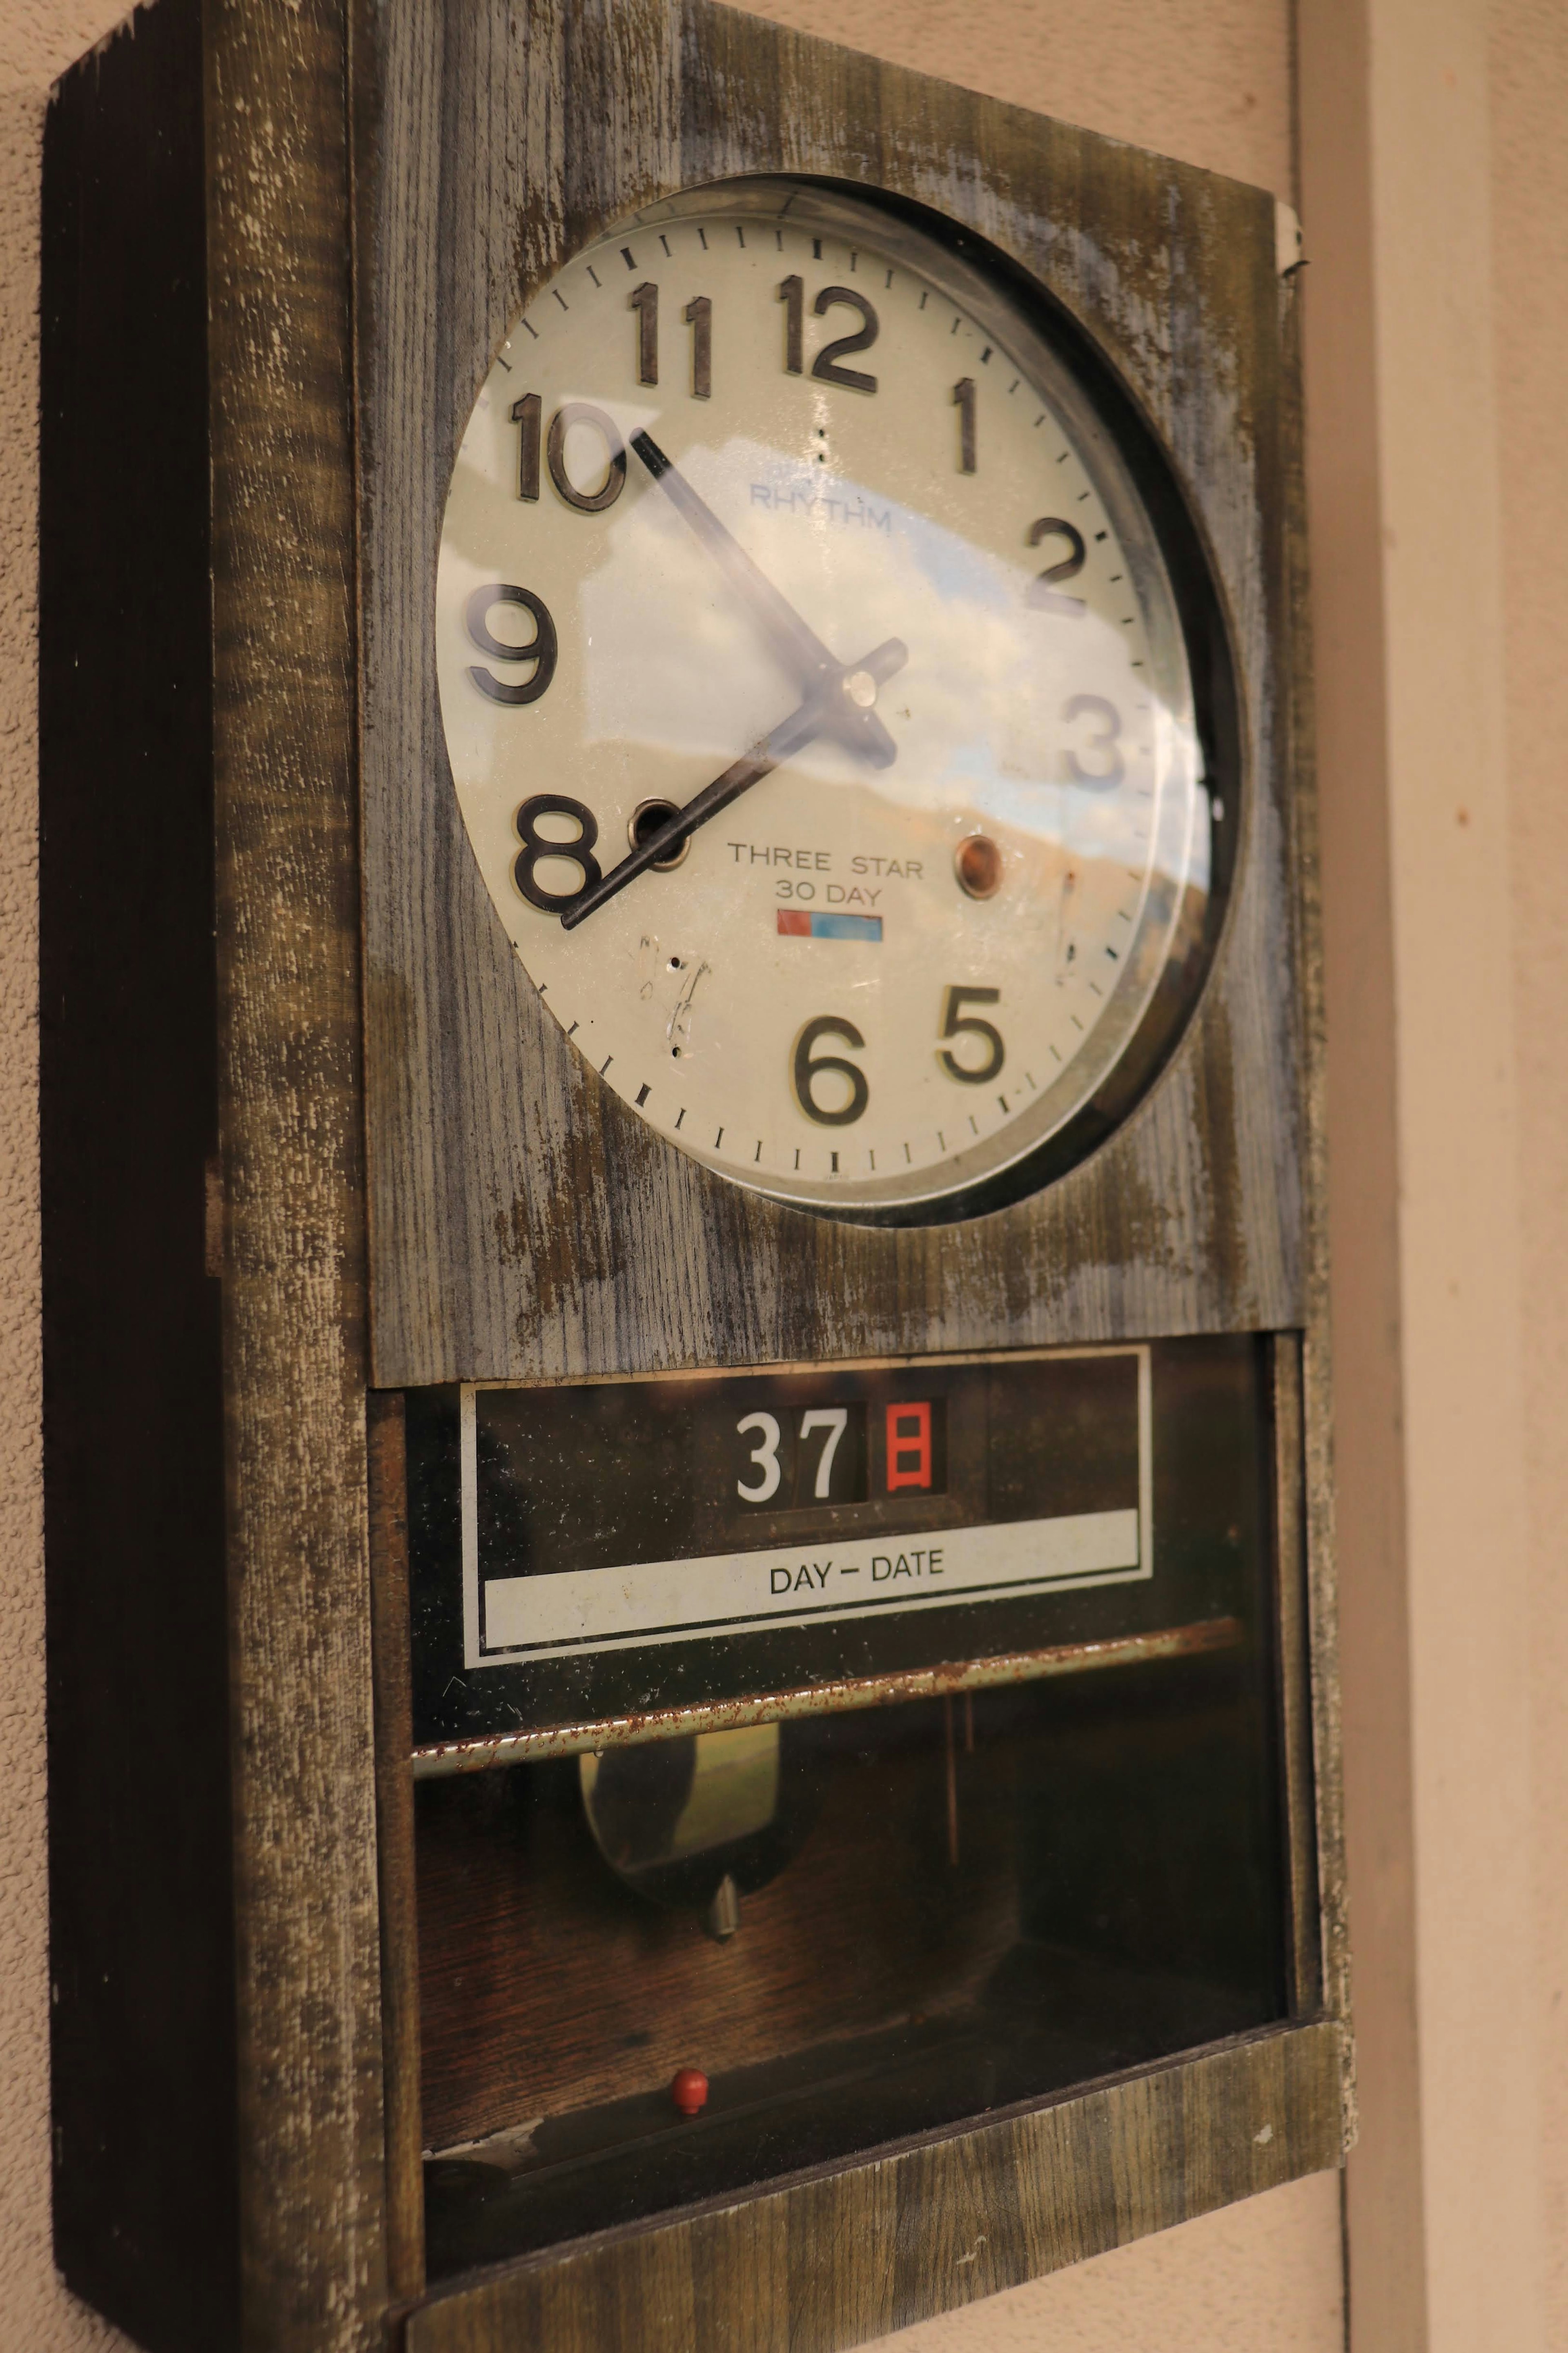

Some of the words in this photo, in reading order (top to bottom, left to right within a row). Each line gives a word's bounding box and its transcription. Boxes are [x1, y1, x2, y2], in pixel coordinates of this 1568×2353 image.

[630, 282, 711, 399] 11
[778, 275, 879, 395] 12
[510, 393, 627, 515] 10
[952, 378, 976, 474] 1
[750, 484, 891, 532] RHYTHM
[1025, 517, 1087, 618] 2
[464, 584, 557, 707] 9
[1063, 694, 1125, 793] 3
[510, 794, 602, 915] 8
[727, 843, 831, 871] THREE
[851, 856, 924, 879] STAR
[776, 880, 815, 900] 30
[826, 884, 882, 907] DAY
[790, 1015, 869, 1126] 6
[936, 985, 1004, 1084] 5
[886, 1401, 931, 1492] 日
